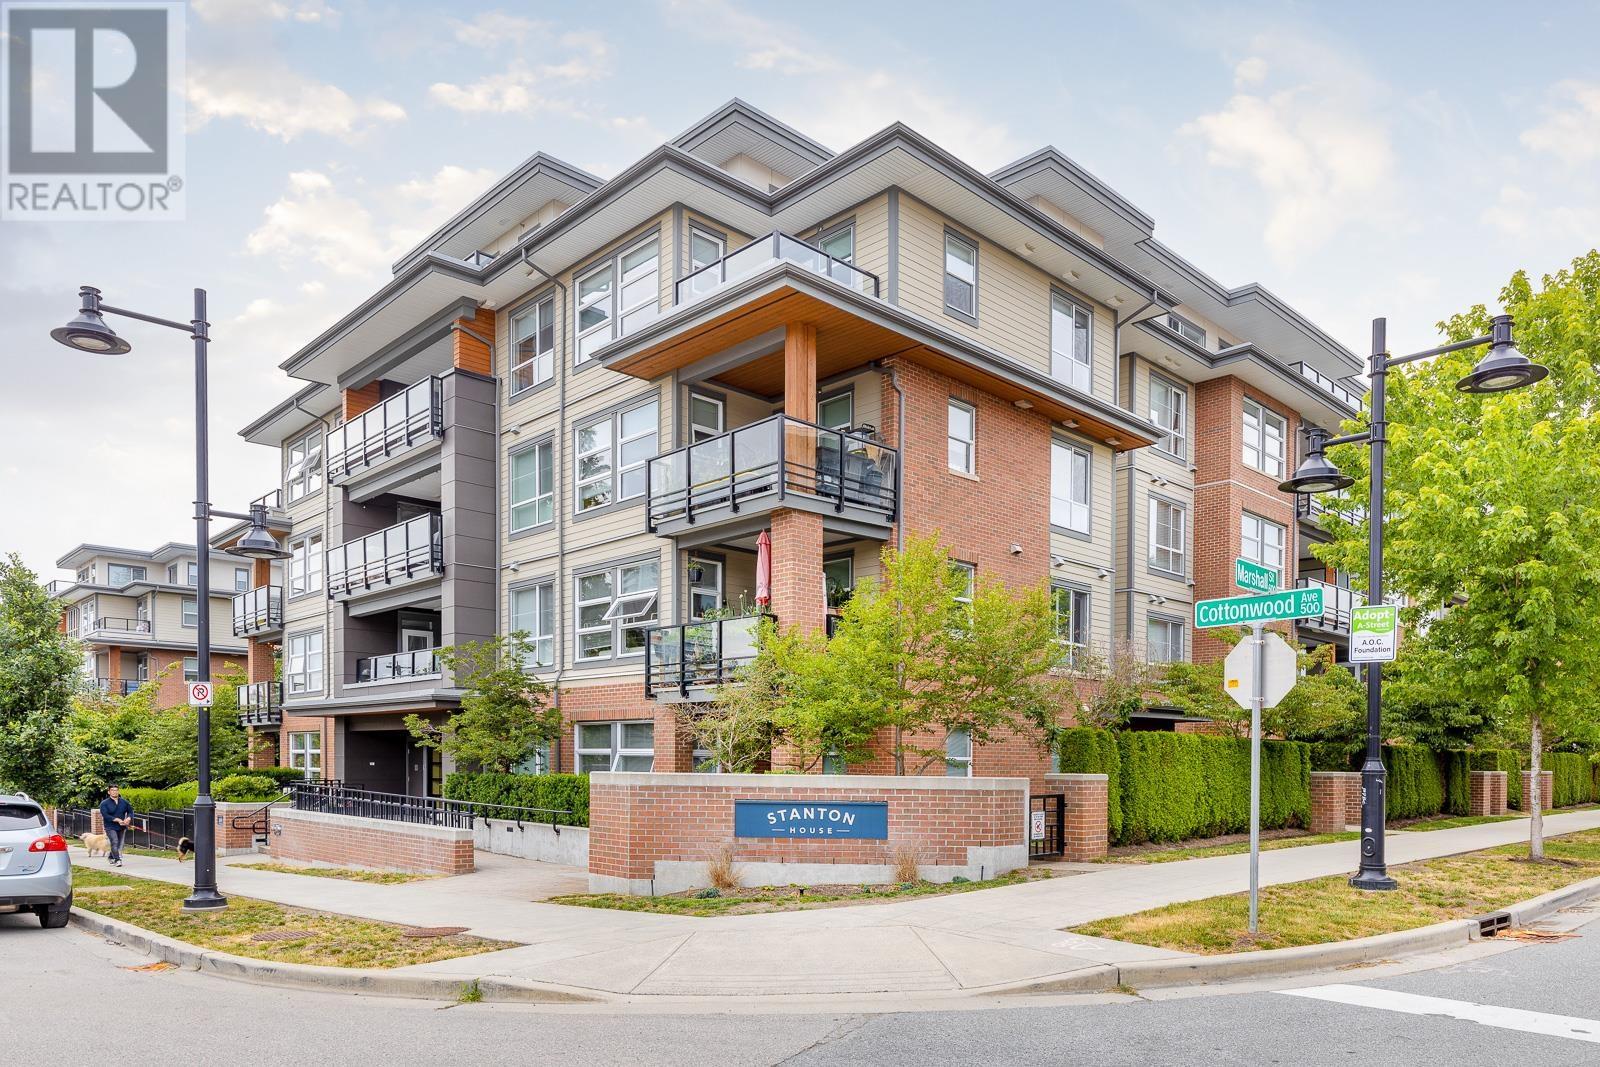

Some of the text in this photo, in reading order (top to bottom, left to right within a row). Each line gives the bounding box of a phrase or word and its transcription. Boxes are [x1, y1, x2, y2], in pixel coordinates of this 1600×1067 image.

[1237, 563, 1269, 590] Marshall
[1199, 591, 1319, 623] Cottonwood Ave
[1300, 602, 1321, 615] 500
[1357, 621, 1390, 629] A-Street
[1361, 638, 1384, 646] A.O.C.
[1354, 645, 1391, 654] Foundation
[767, 807, 856, 825] STANTON
